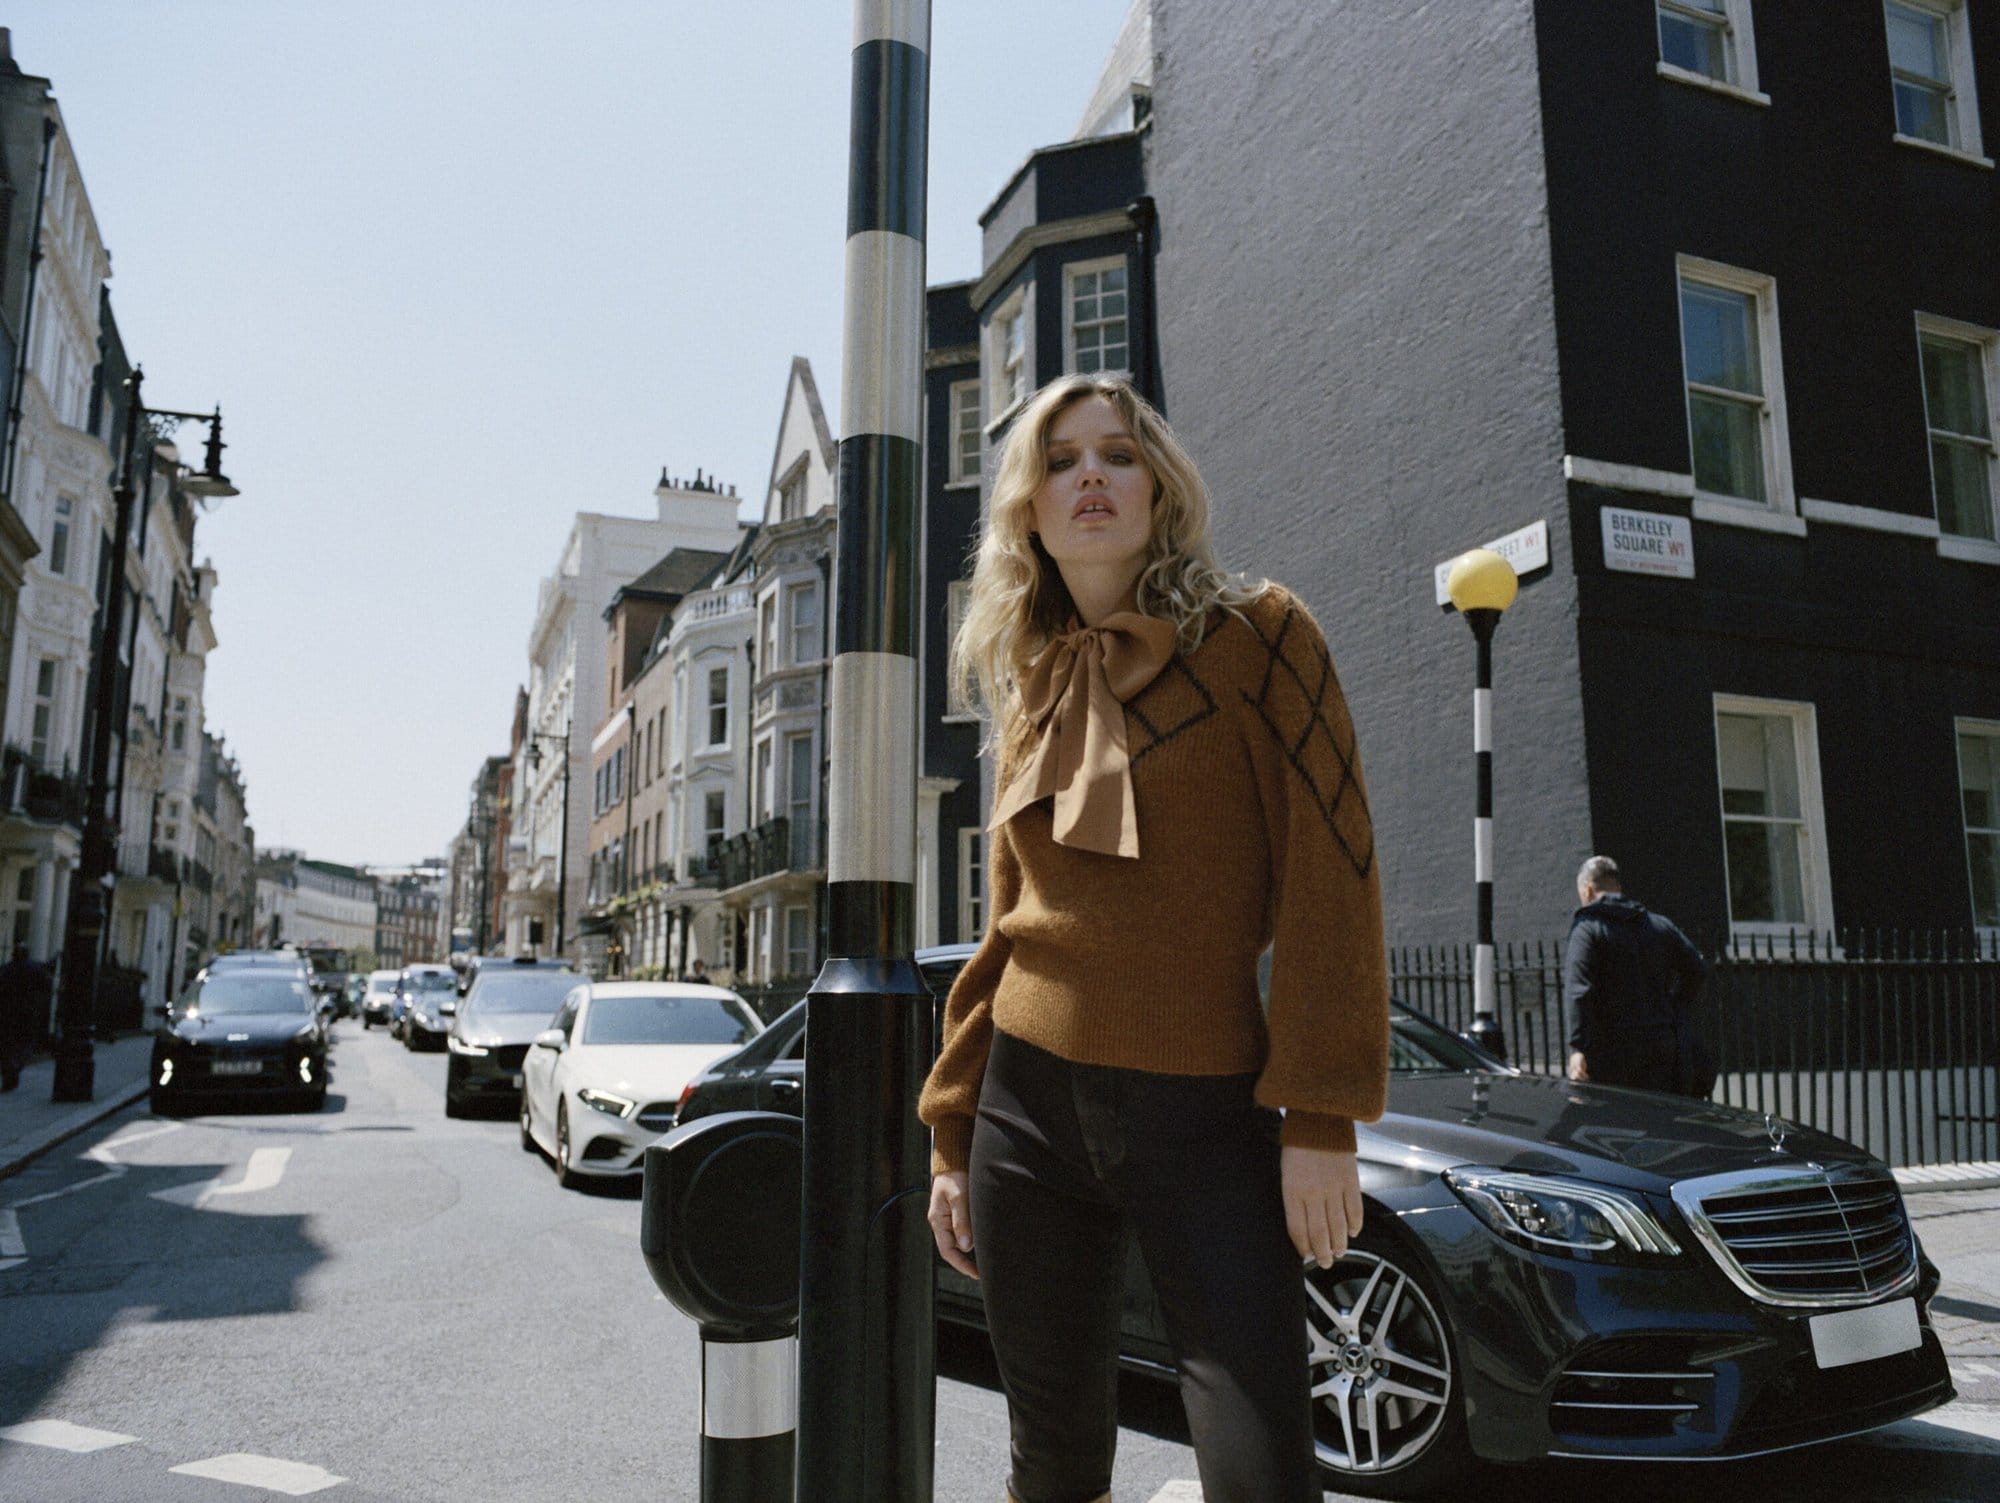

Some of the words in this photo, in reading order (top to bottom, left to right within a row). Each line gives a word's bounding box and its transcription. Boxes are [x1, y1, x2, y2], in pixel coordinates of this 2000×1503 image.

[1612, 513, 1673, 538] BERKELEY
[1524, 531, 1539, 548] W1
[1613, 533, 1664, 555] SQUARE
[1667, 541, 1685, 557] W1
